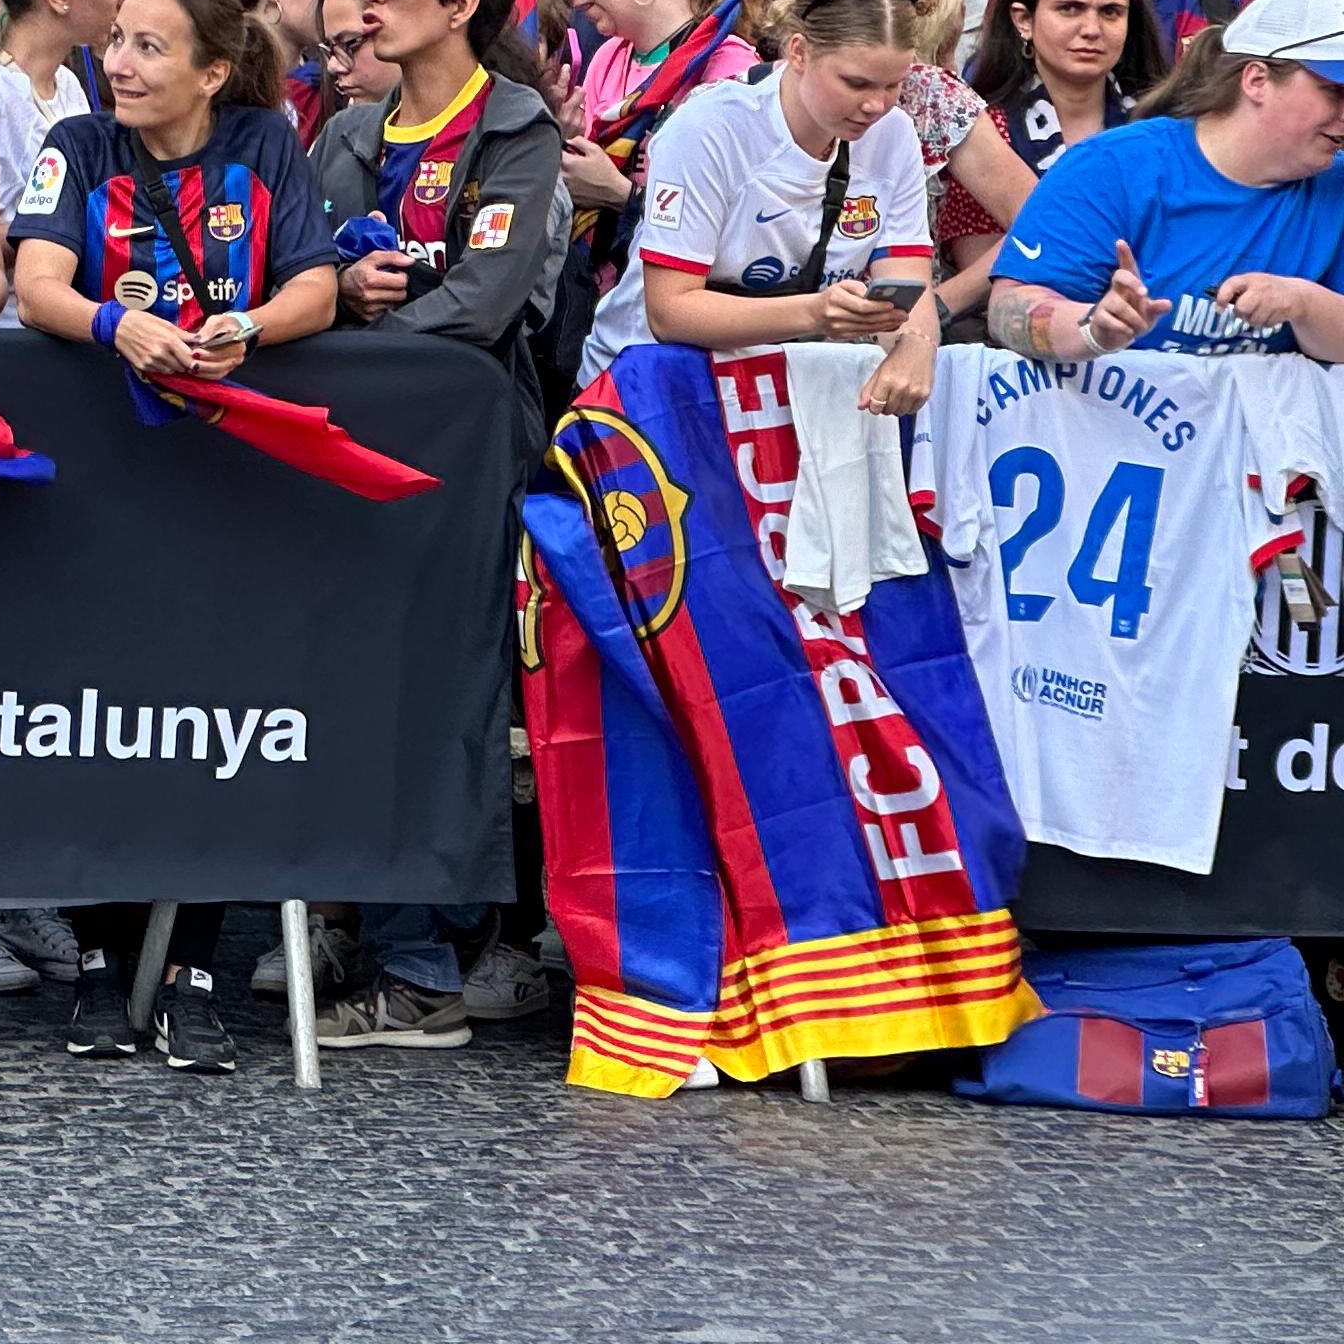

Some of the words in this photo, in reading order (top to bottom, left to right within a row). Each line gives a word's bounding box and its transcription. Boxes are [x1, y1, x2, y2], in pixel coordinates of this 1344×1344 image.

[163, 277, 243, 306] Sptify
[988, 446, 1166, 639] 24
[1042, 668, 1107, 698] UNHCR
[1039, 684, 1104, 714] ACNUR
[848, 744, 965, 883] FC
